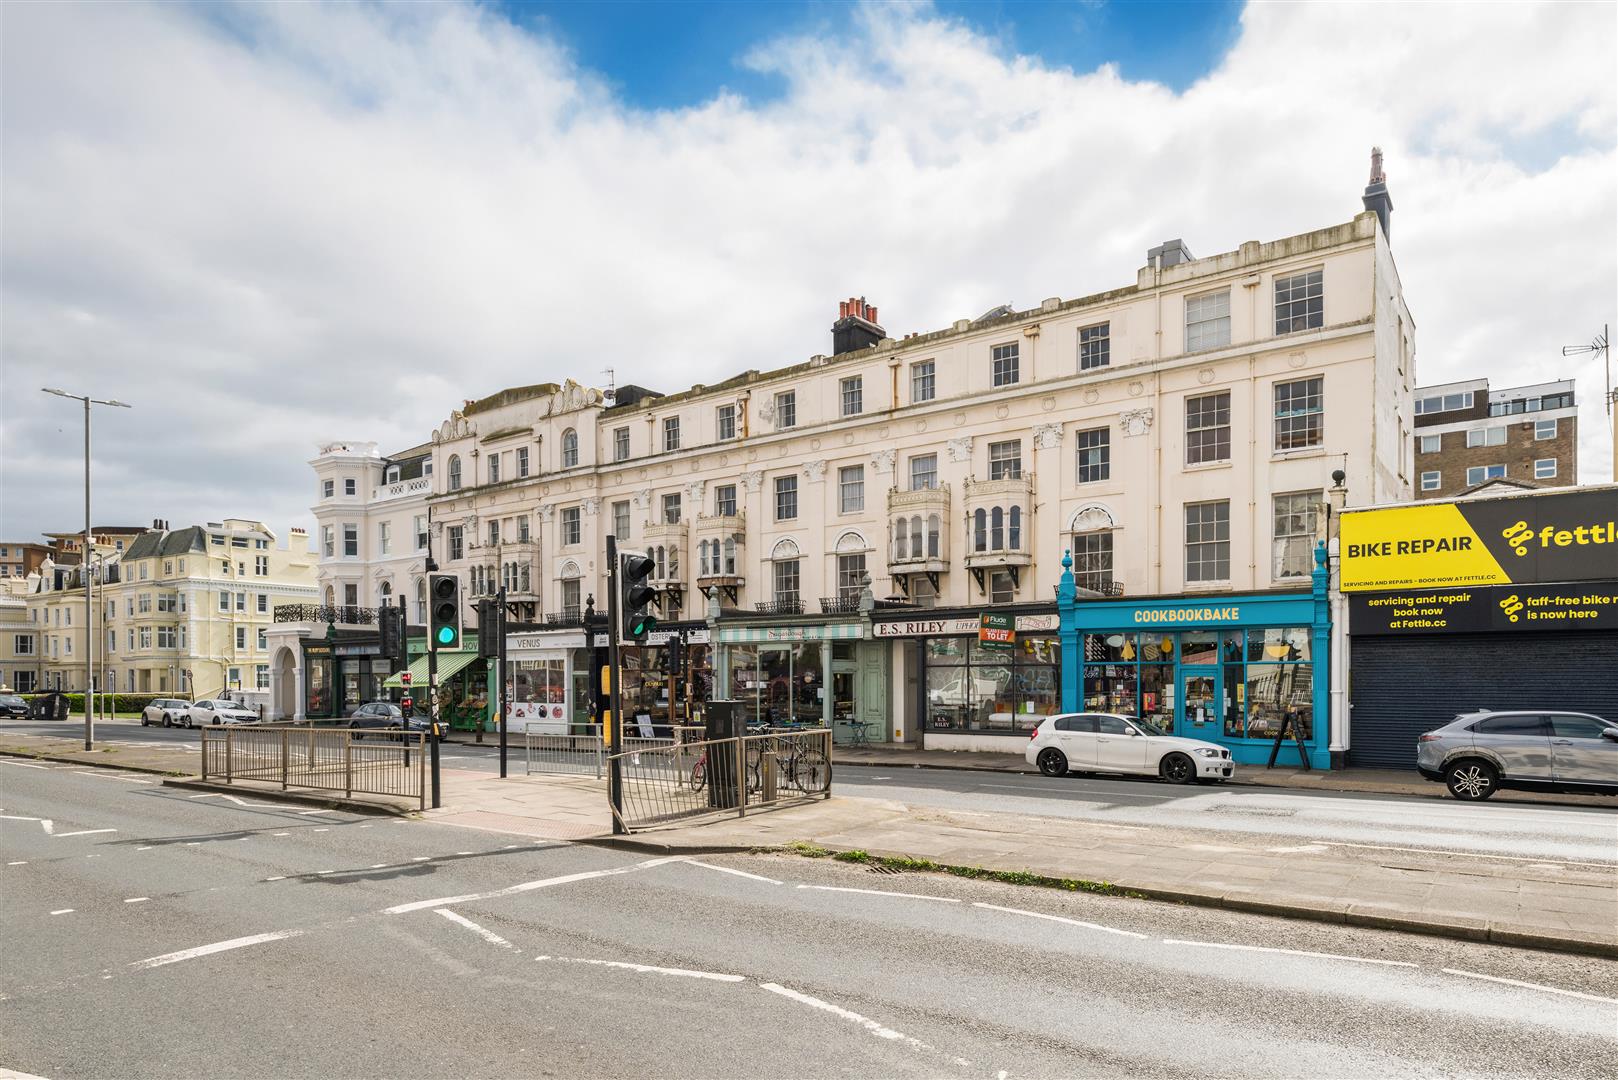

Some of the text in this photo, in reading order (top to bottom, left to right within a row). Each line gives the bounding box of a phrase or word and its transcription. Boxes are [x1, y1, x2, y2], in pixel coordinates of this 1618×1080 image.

[1538, 521, 1618, 548] fettl
[1348, 536, 1472, 558] BIKE REPAIR
[1368, 593, 1471, 607] servicing and repair
[1527, 596, 1580, 606] faff-free
[1582, 595, 1610, 605] bike
[1134, 607, 1240, 623] COOKBOOKBAKE
[1393, 607, 1443, 617] book now
[1527, 610, 1598, 619] is now here
[880, 623, 902, 635] E.S.
[906, 621, 946, 634] RILEY
[1389, 619, 1447, 629] at Fettle.cc
[987, 632, 1008, 641] TO LET
[517, 638, 541, 648] VENUS
